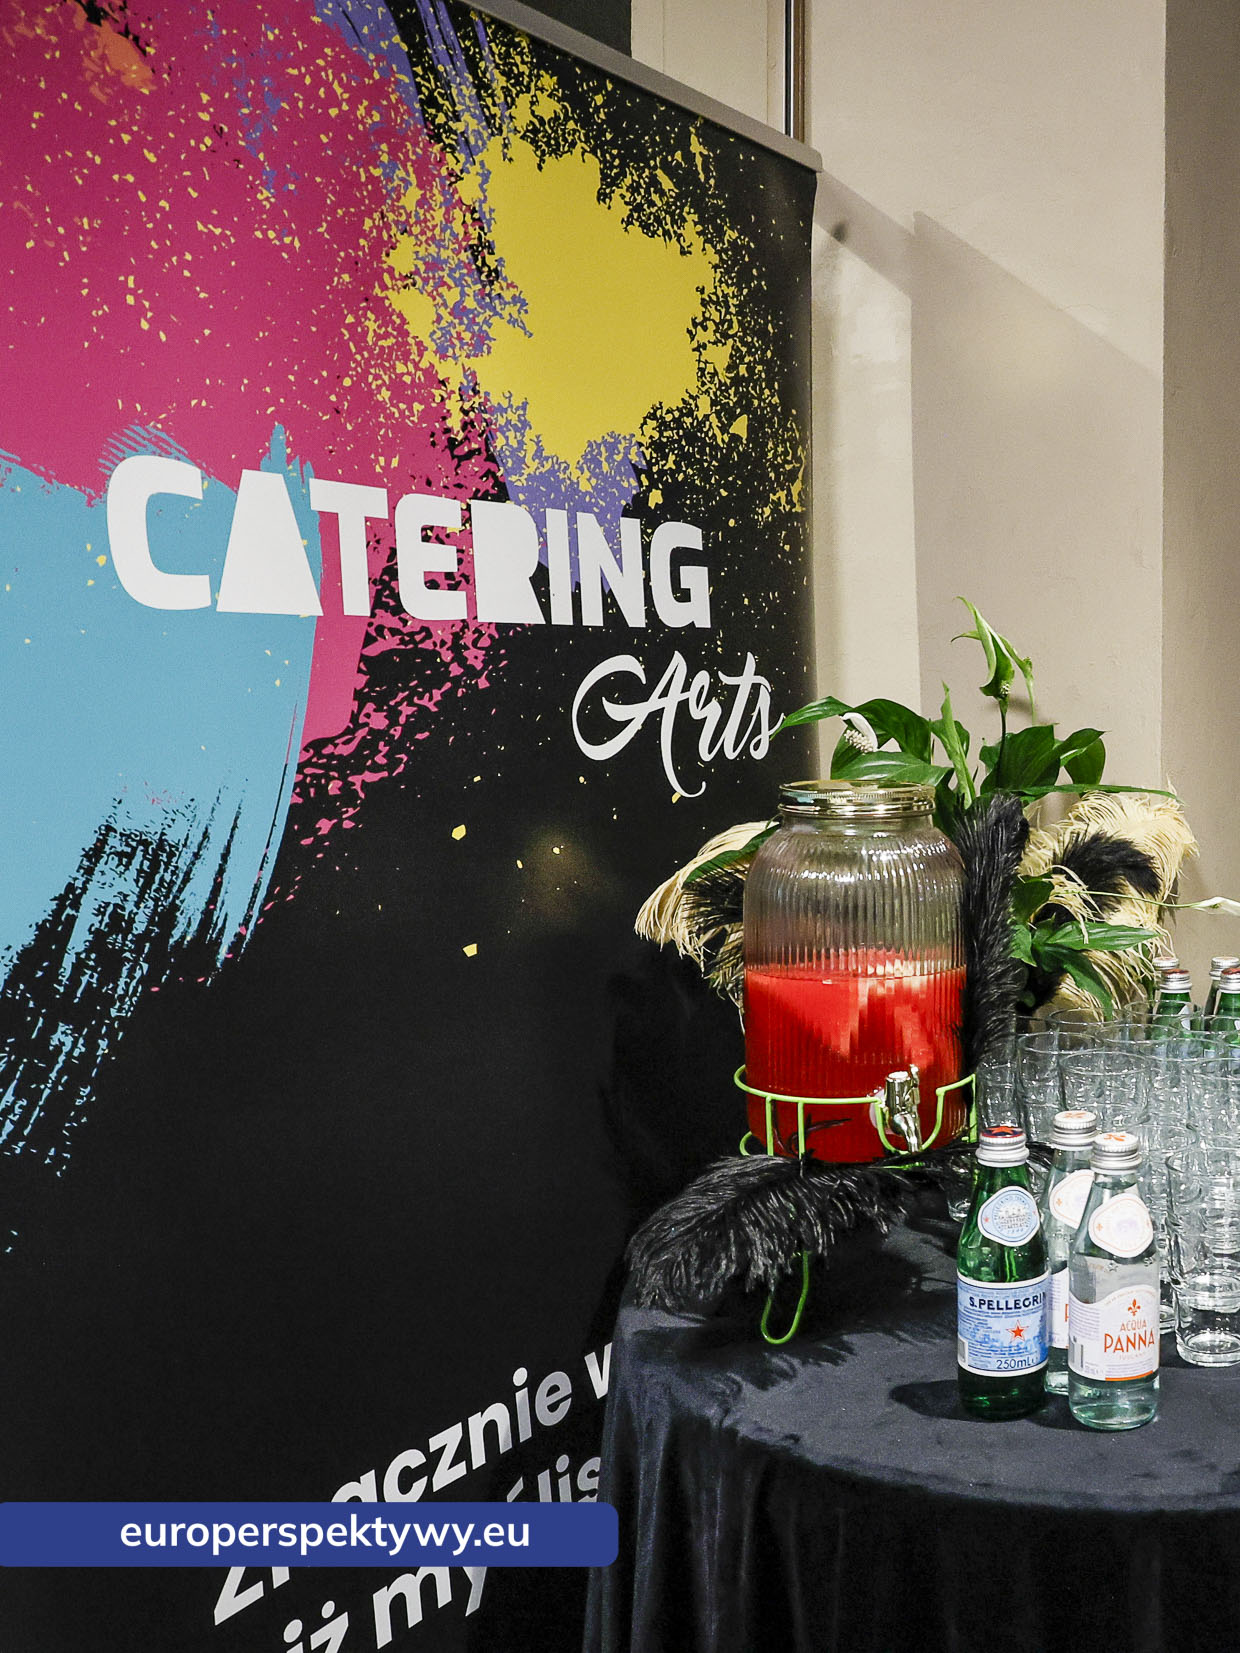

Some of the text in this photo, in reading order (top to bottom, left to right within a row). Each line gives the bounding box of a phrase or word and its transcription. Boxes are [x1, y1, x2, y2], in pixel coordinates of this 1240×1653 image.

[106, 455, 711, 628] CATERING
[571, 650, 786, 798] Arts
[1103, 1328, 1155, 1353] PANNA
[1120, 1319, 1147, 1332] ACQUA
